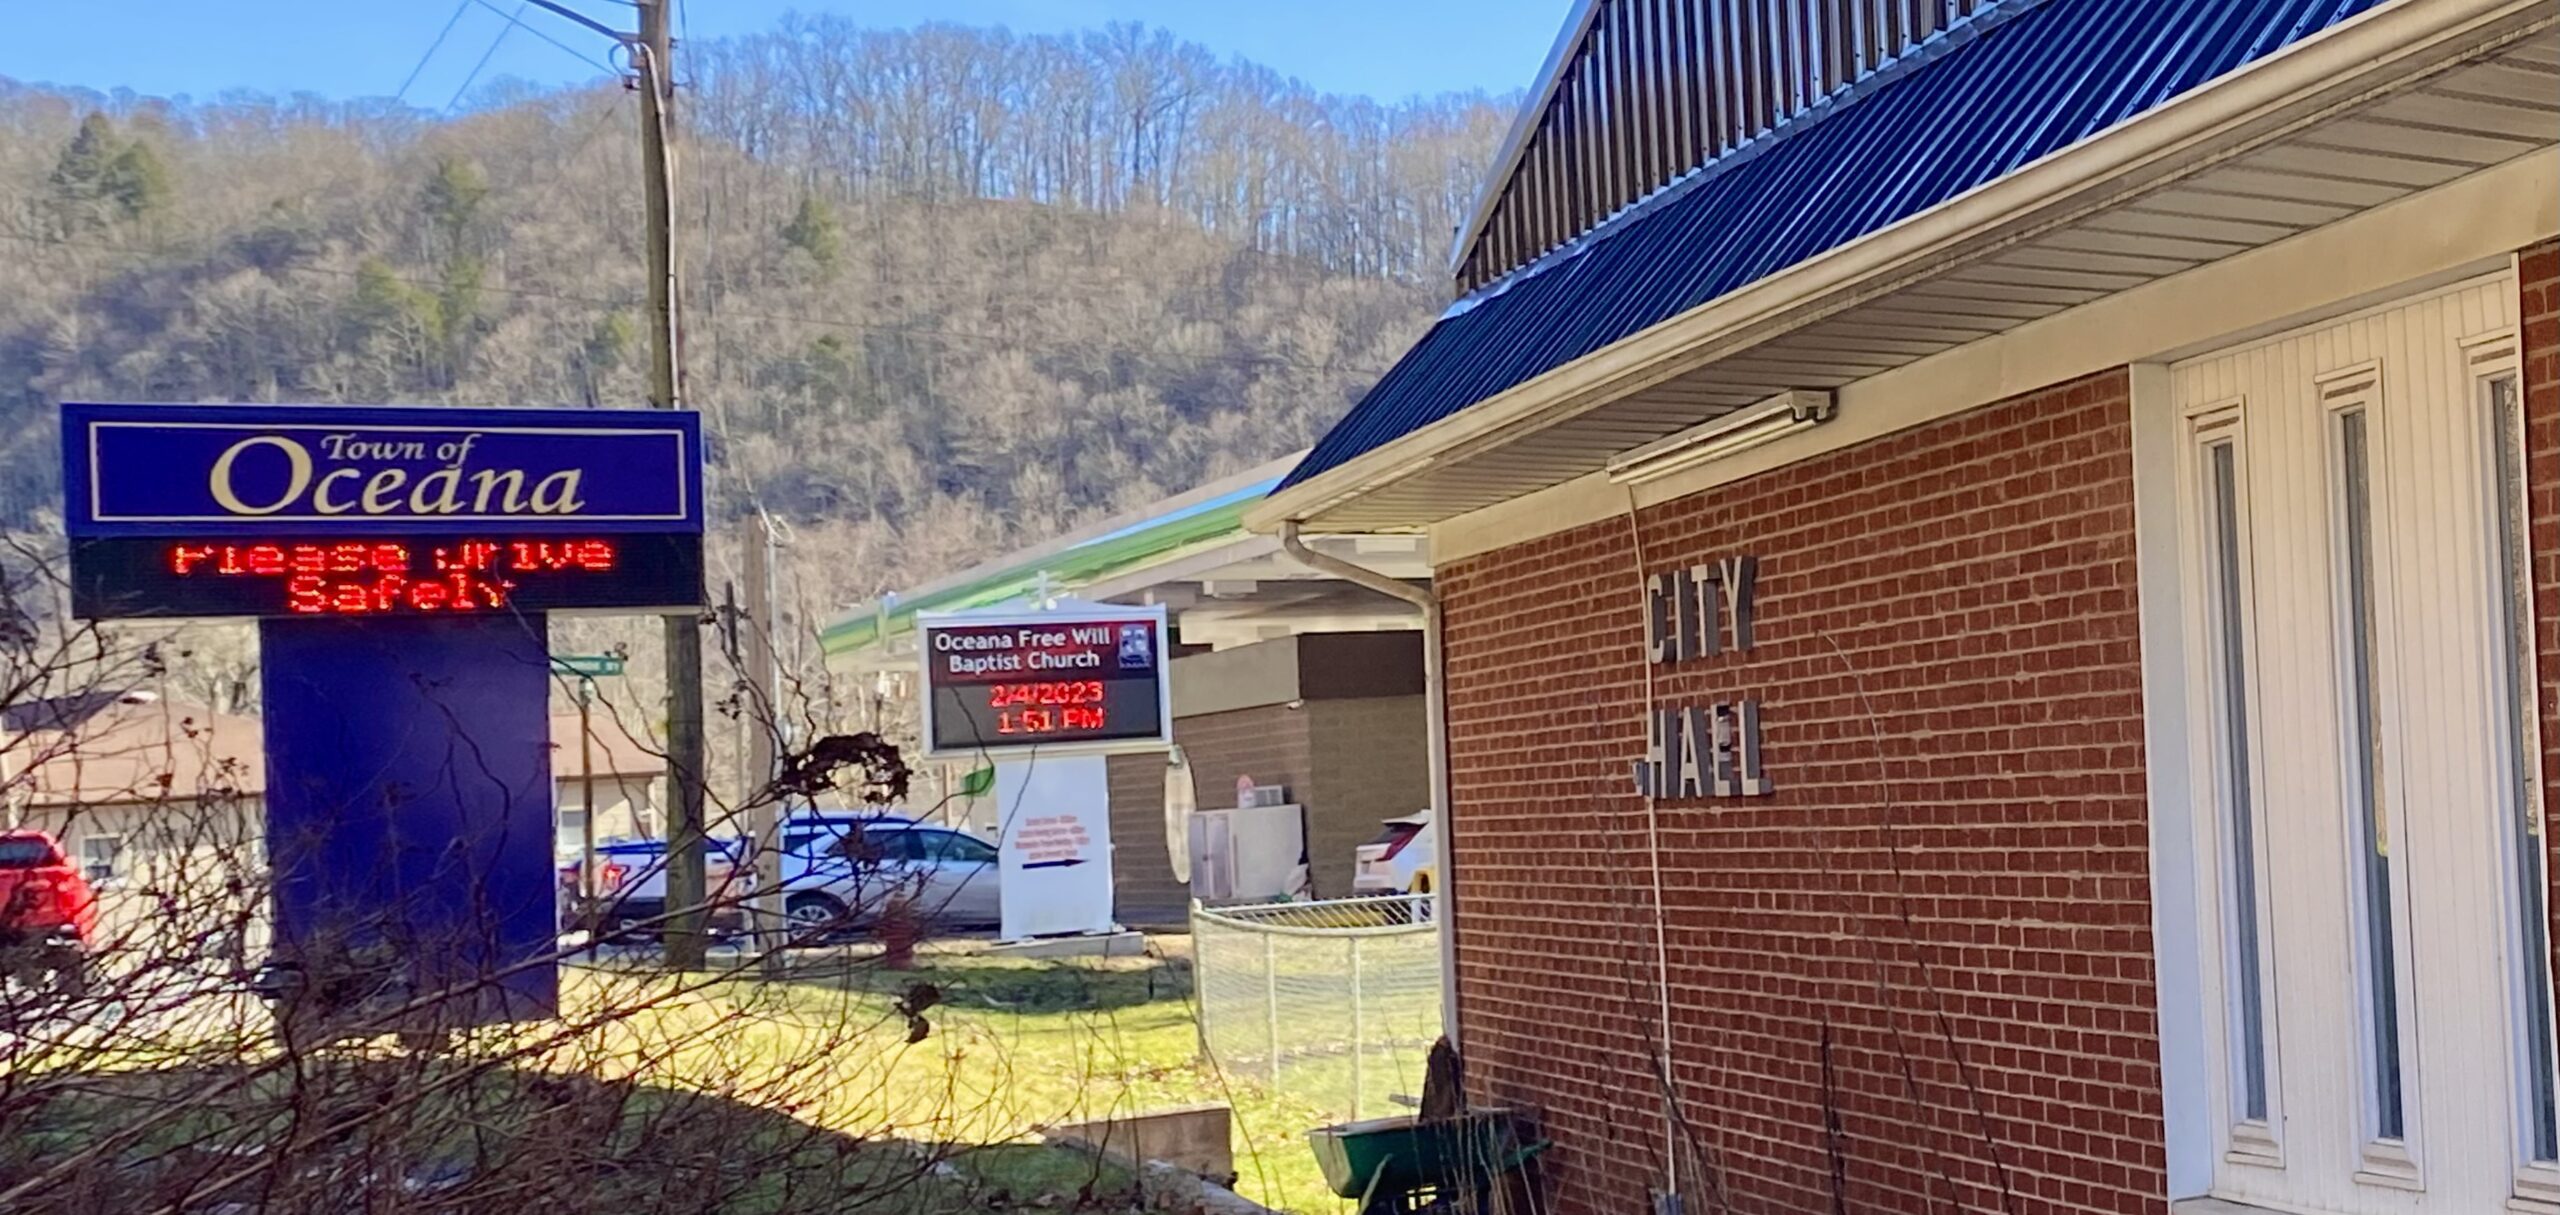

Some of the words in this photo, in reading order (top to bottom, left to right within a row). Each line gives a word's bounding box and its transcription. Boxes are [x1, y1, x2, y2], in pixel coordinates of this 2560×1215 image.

[320, 433, 426, 461] Town
[436, 433, 483, 469] of
[209, 435, 587, 515] Oceana
[288, 573, 516, 613] Safely
[1647, 556, 1757, 664] CITY
[934, 632, 1013, 652] Oceana
[1018, 629, 1066, 649] Free
[1071, 626, 1111, 646] Will
[949, 653, 1022, 676] Baptist
[1027, 649, 1100, 670] Church
[989, 681, 1104, 708] 2/4/2023
[1062, 706, 1104, 730] PM
